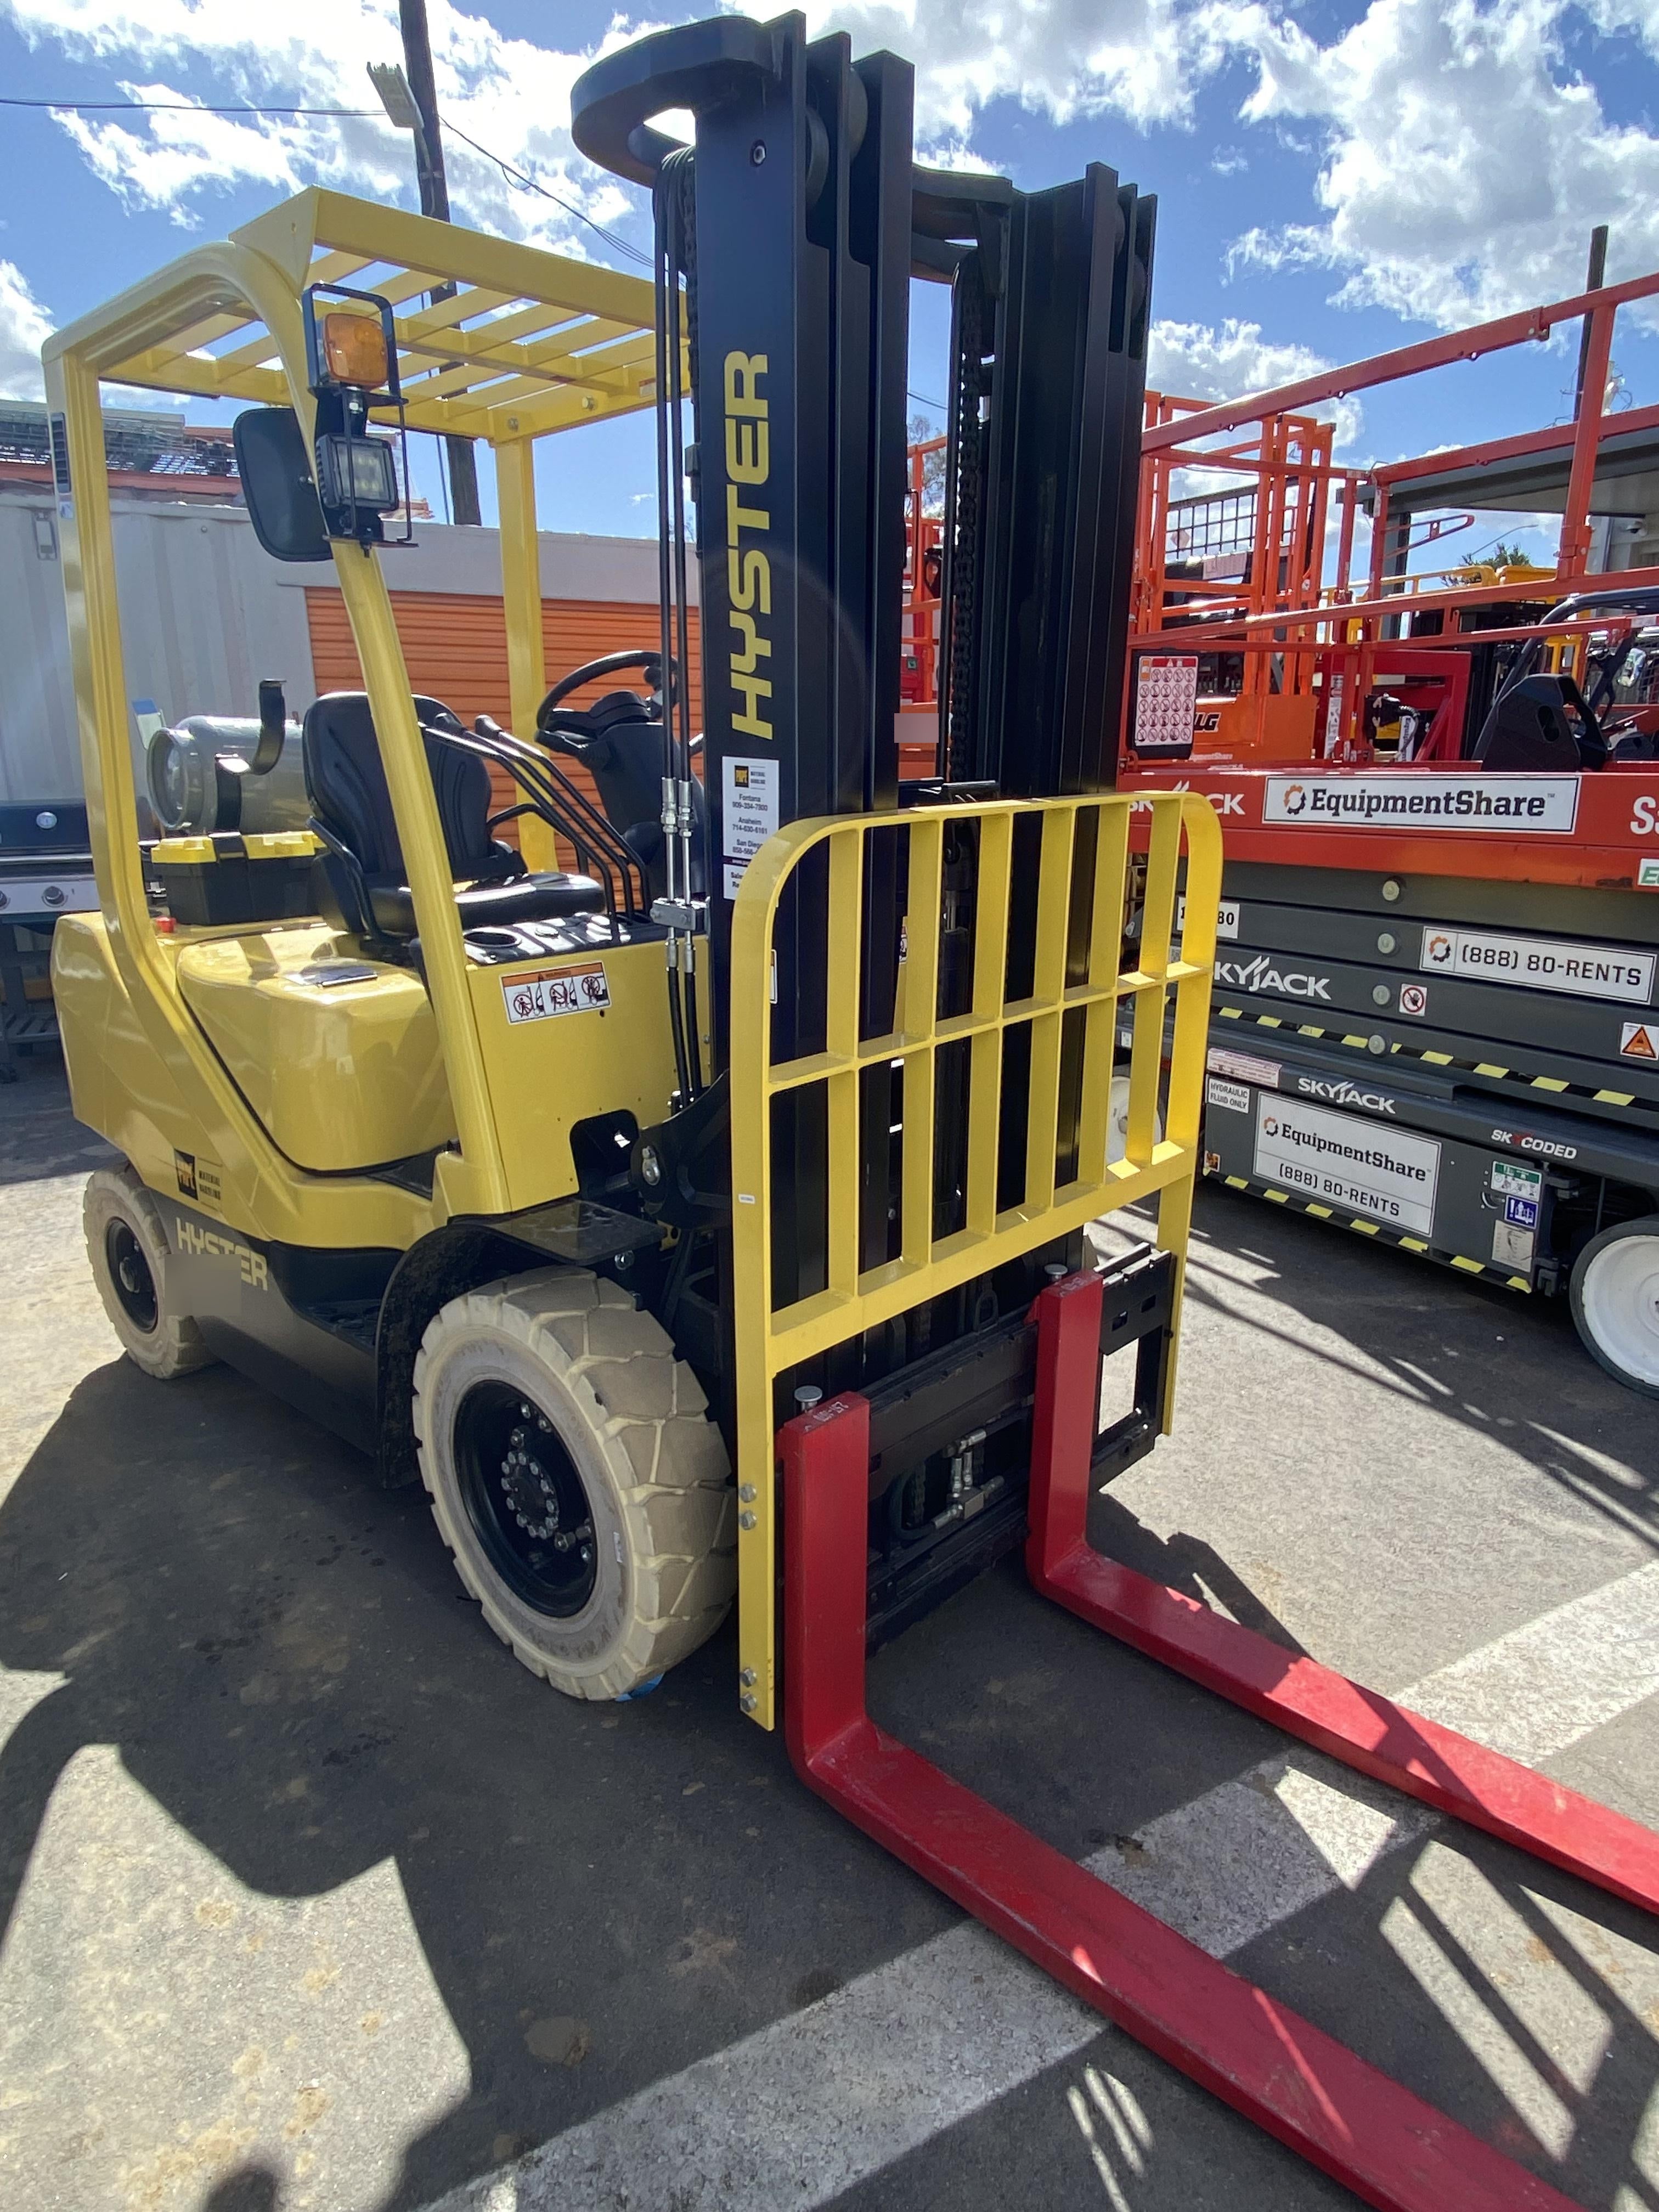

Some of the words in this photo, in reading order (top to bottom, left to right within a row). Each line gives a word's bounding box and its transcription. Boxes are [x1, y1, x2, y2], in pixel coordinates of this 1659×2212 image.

[724, 350, 773, 740] HYSTER
[1311, 788, 1546, 818] EquipmentShare
[1630, 796, 1659, 835] S
[1214, 955, 1332, 1000] KYJACK
[1462, 944, 1519, 969] (888)
[1527, 954, 1642, 986] 80-RENTS
[1210, 1082, 1248, 1098] HYDRAULIC
[1210, 1092, 1229, 1104] FLUID
[1229, 1098, 1248, 1109] ONLY
[1298, 1077, 1396, 1114] SKYJACK
[1282, 1123, 1427, 1182] EquipmentShare
[1279, 1163, 1318, 1189] (888)
[1324, 1179, 1400, 1217] 80-RENTS
